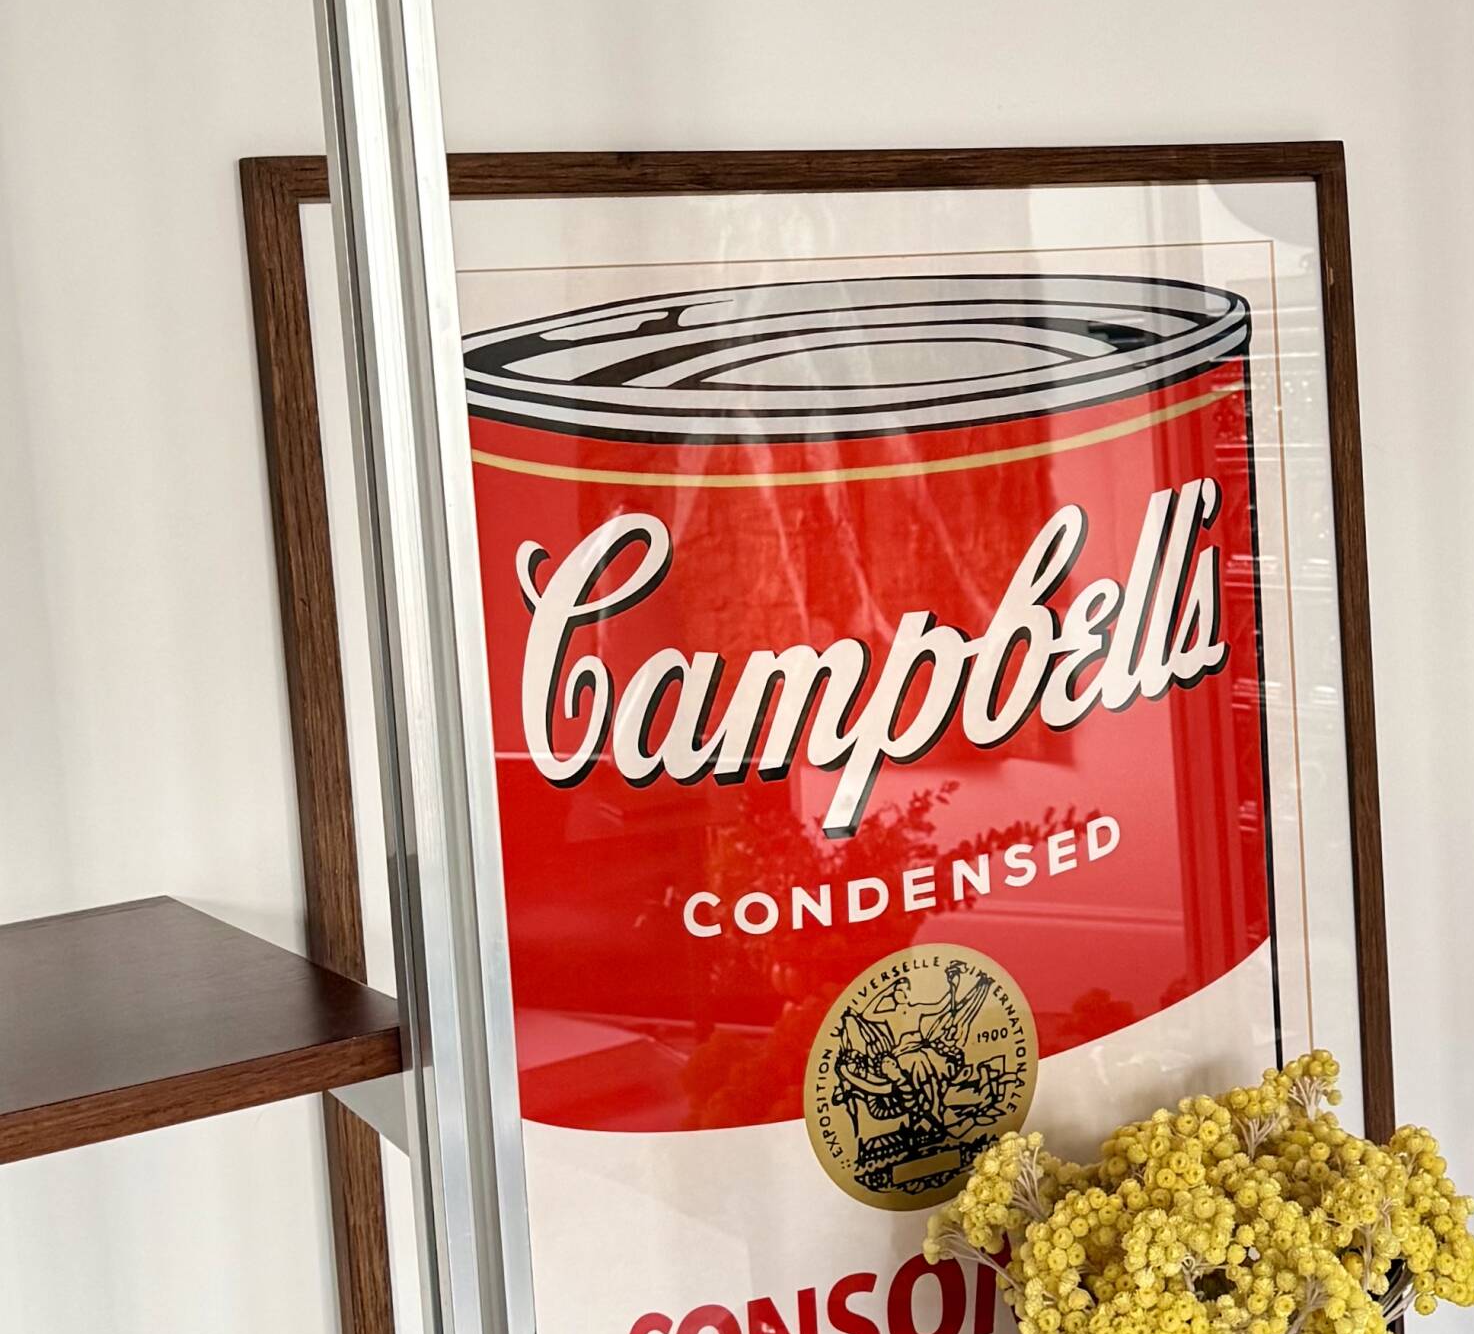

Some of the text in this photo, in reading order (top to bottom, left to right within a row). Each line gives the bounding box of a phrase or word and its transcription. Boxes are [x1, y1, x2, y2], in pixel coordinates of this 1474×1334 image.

[515, 478, 1228, 839] Campbell's
[682, 816, 1122, 939] CONDENSED
[976, 1027, 1009, 1044] 1900
[815, 1049, 845, 1159] EXPOSITION
